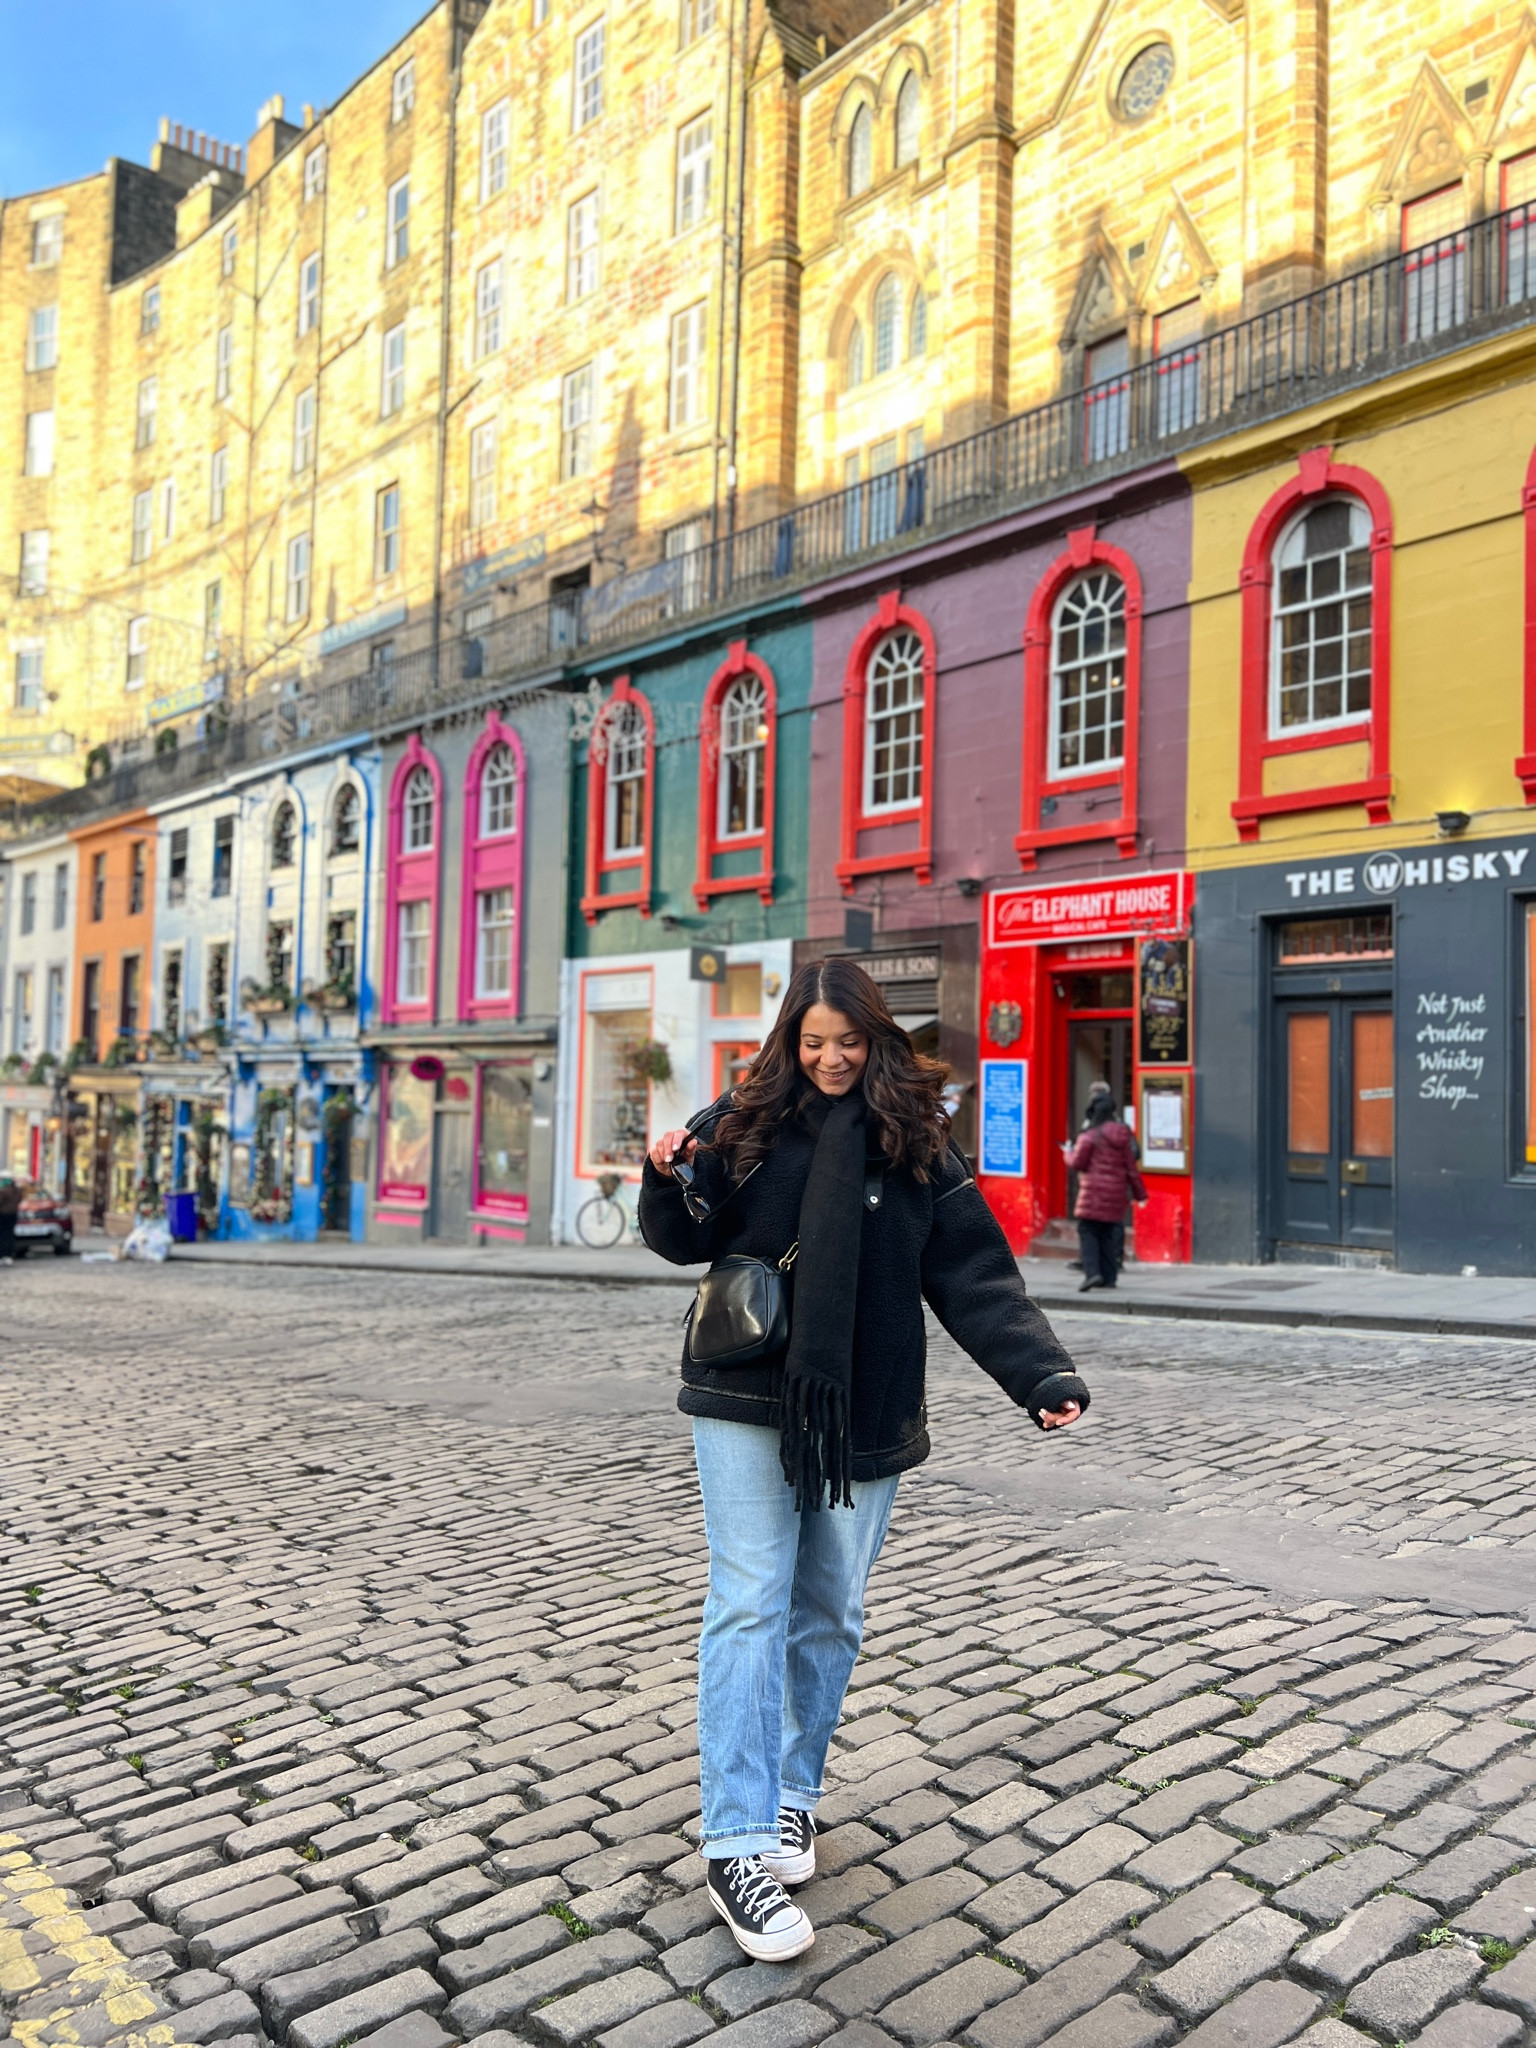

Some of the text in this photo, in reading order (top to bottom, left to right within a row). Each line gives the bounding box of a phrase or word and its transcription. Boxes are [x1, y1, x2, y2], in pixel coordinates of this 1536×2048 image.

[1286, 848, 1530, 897] THE WHISKY
[998, 885, 1171, 929] The ELEPHANT HOUSE
[906, 956, 937, 975] SON
[1416, 991, 1448, 1015] Not
[1416, 1020, 1488, 1044] Another
[1416, 1048, 1484, 1081] Whisky
